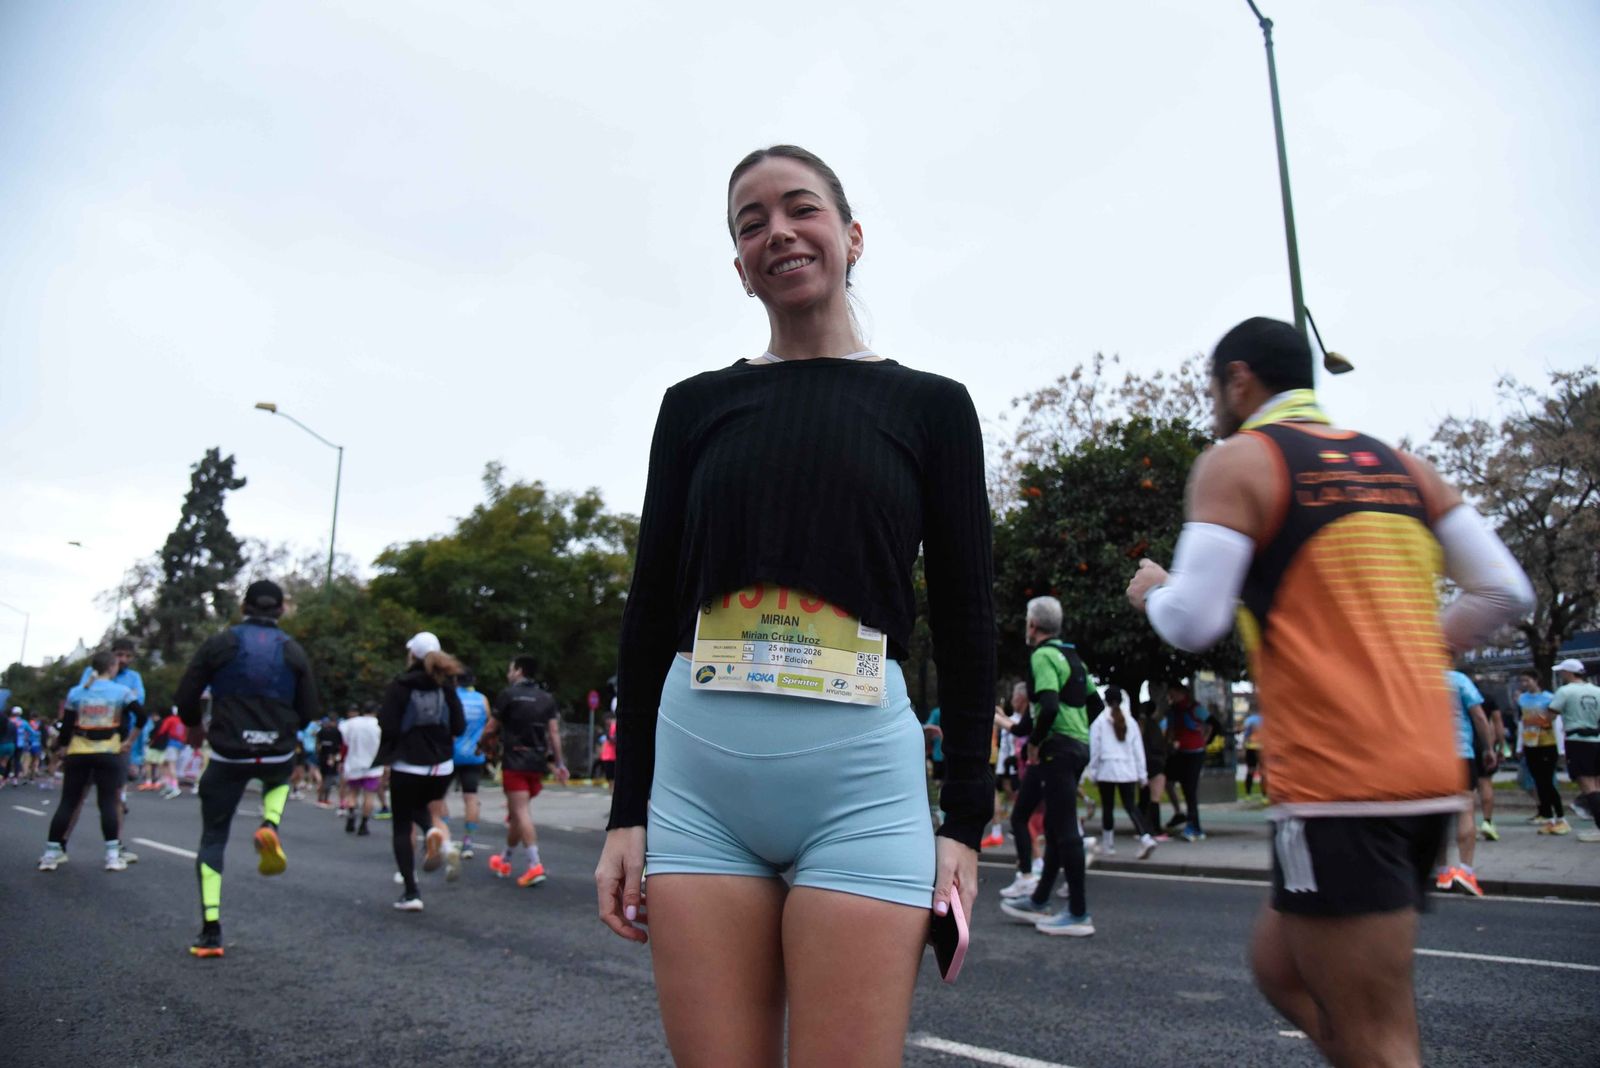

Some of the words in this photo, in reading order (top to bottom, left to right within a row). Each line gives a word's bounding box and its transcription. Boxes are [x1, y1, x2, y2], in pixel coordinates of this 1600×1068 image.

[761, 614, 800, 626] MIRIAN
[741, 631, 768, 640] Mirian
[771, 632, 794, 642] Cruz
[797, 634, 820, 645] Uroz
[768, 644, 778, 652] 25
[779, 646, 802, 654] enero
[803, 648, 822, 656] 2026
[746, 672, 774, 683] HOKA
[781, 676, 818, 687] Sprinter
[826, 689, 852, 697] HYUNDAI
